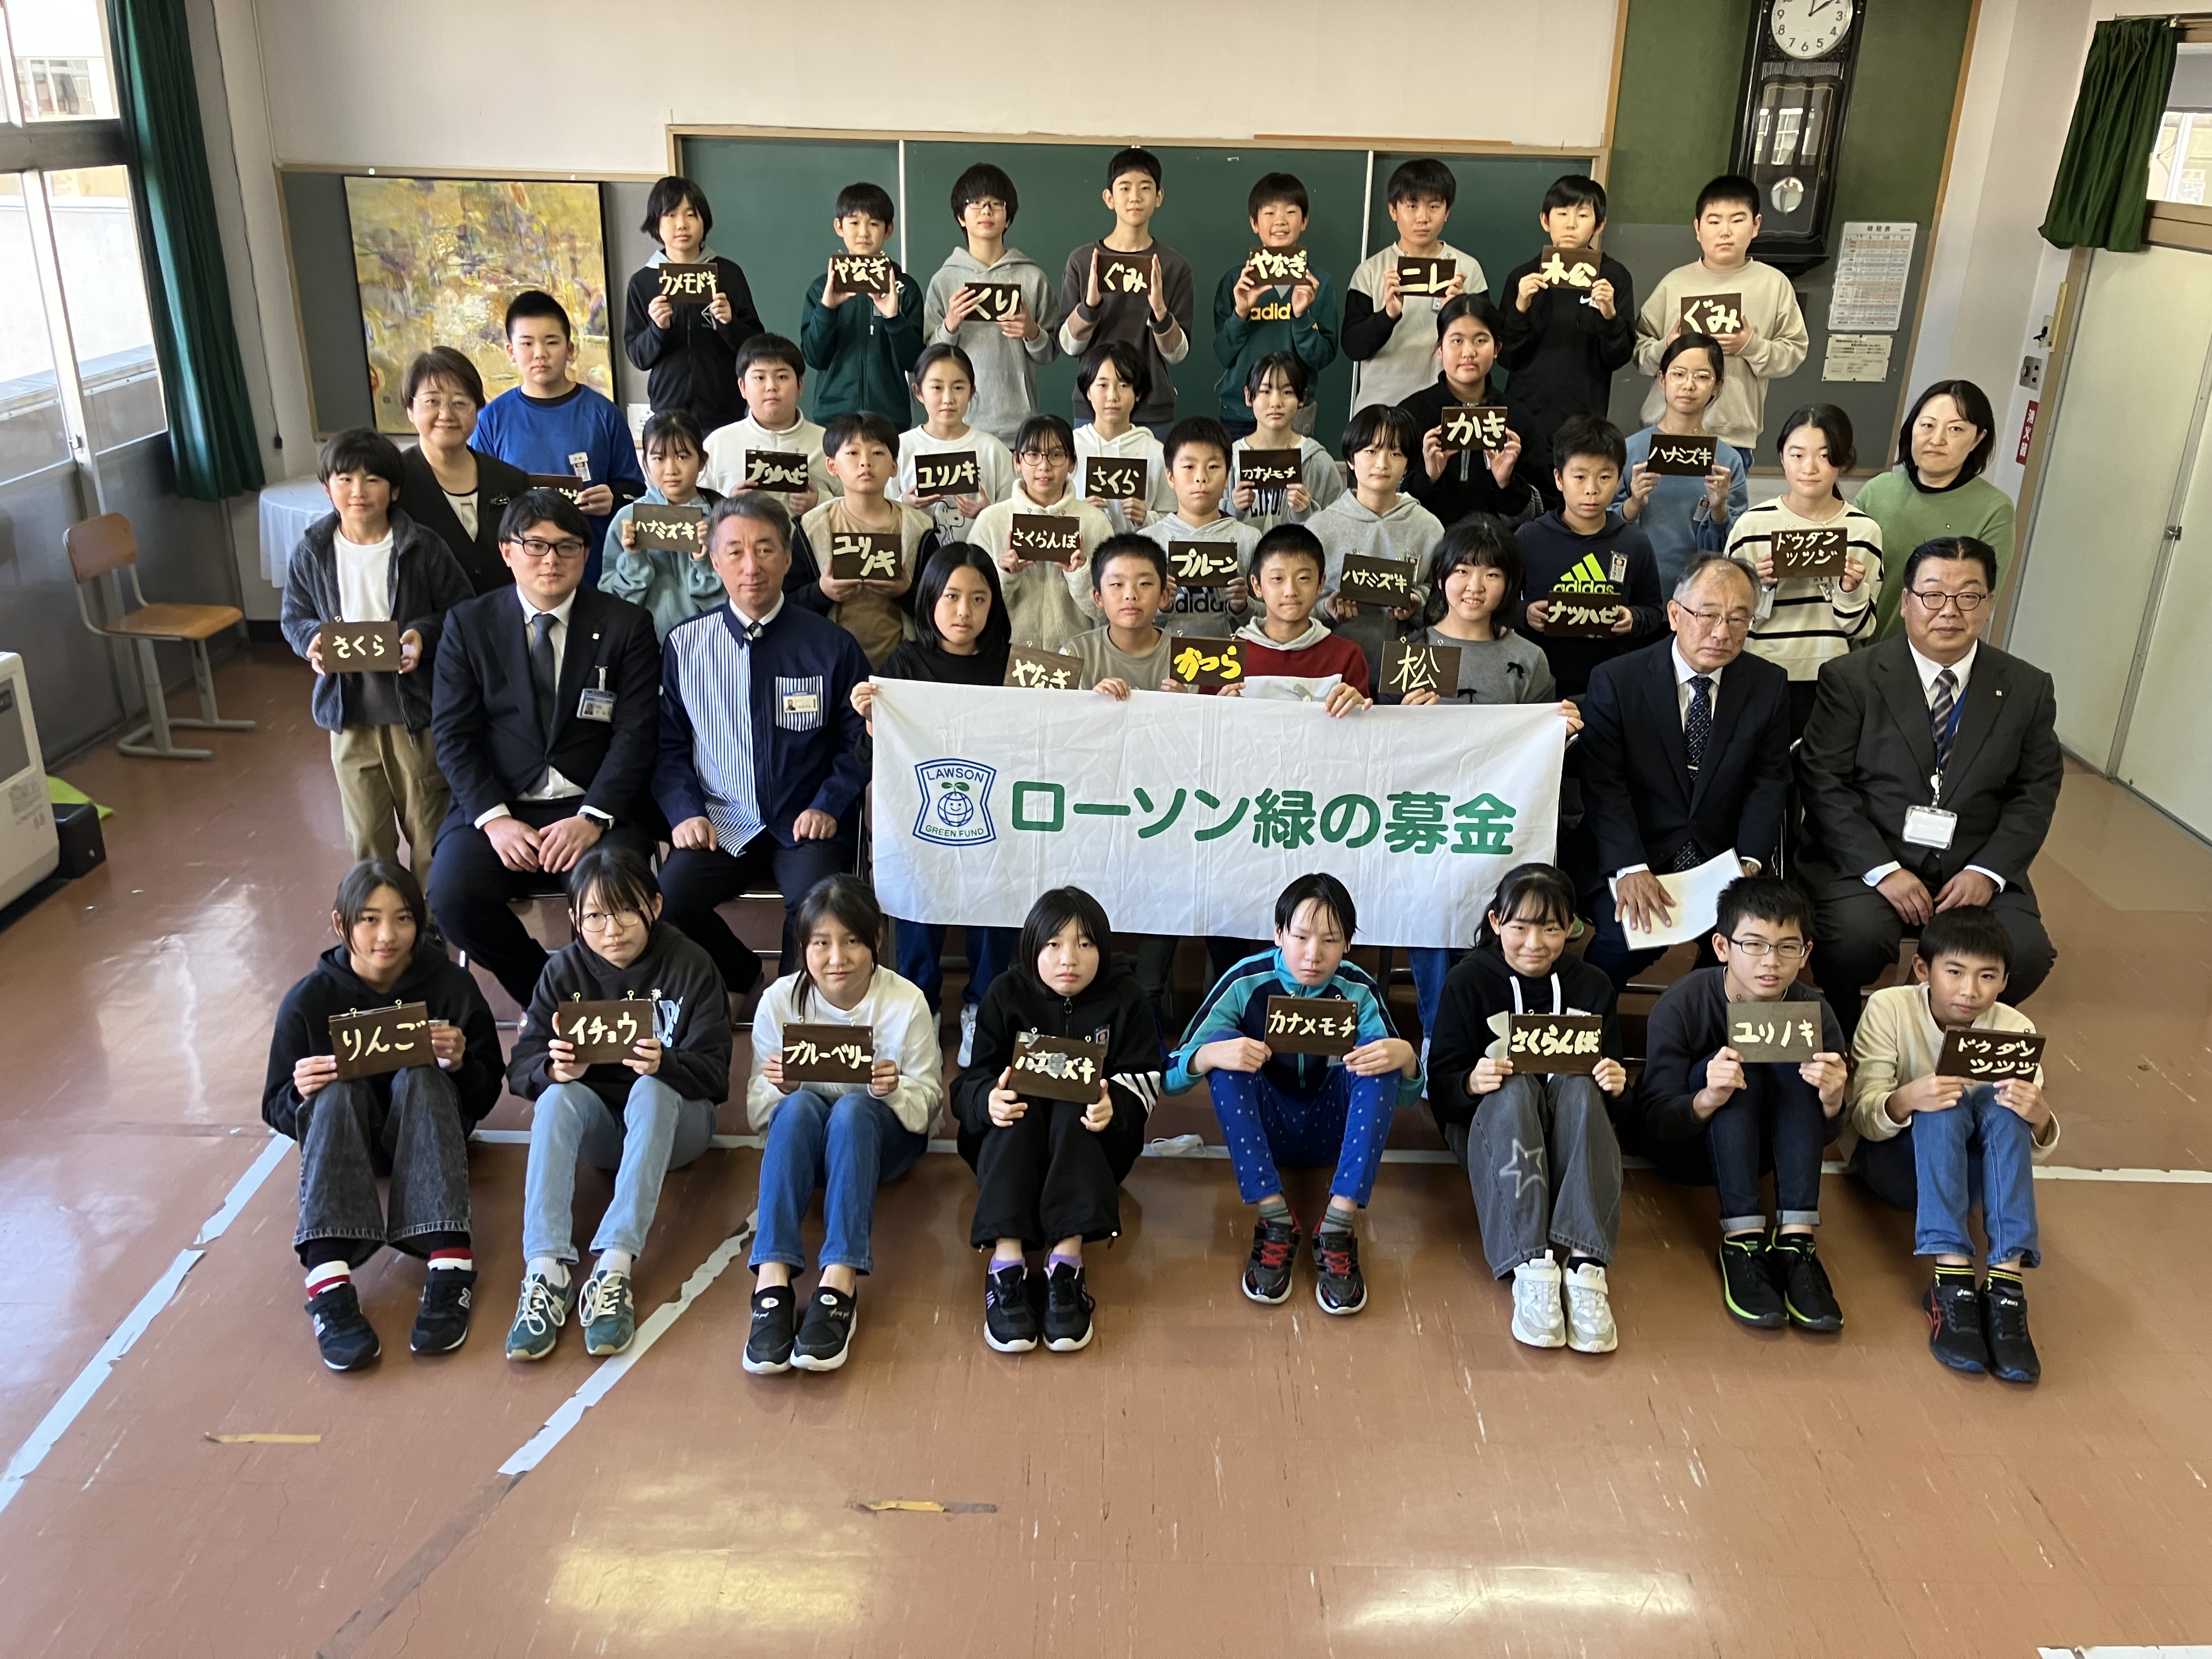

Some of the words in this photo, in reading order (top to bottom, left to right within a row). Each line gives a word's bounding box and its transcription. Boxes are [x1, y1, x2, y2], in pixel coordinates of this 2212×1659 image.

[1777, 9, 1785, 20] 9
[1836, 10, 1843, 21] 3
[1778, 25, 1785, 35] 8
[1788, 38, 1796, 48] 7
[1816, 38, 1824, 48] 5
[1829, 26, 1838, 36] 4
[1801, 42, 1809, 52] 6
[834, 257, 889, 290] やなぎ
[1104, 262, 1148, 293] ぐみ
[1250, 249, 1307, 279] やなぎ
[659, 269, 716, 300] ウメモドキ
[1400, 263, 1450, 294] ニレ
[975, 287, 1019, 321] くり
[1250, 303, 1291, 320] adid
[1684, 300, 1740, 334] ぐみ
[1447, 410, 1506, 448] かき
[1648, 445, 1712, 466] ハナミズキ
[918, 460, 980, 489] ユリノキ
[1090, 465, 1139, 495] さくら
[1242, 466, 1296, 482] カナメモチ
[636, 520, 695, 540] ハナミズキ
[1012, 527, 1079, 550] さくらんぼ
[1777, 531, 1840, 552] ドウダン
[833, 535, 872, 560] ユリ
[860, 549, 896, 578] ノキ
[1171, 549, 1238, 577] プルーン
[1342, 569, 1408, 594] ハナミズキ
[1170, 586, 1229, 613] dida
[1548, 600, 1620, 625] ナツハゼ
[332, 634, 385, 659] さくら
[1012, 659, 1070, 690] やなぎ
[1173, 645, 1242, 682] かつら
[1389, 645, 1441, 693] 松
[926, 767, 985, 783] LAWSON
[925, 825, 956, 838] GREEN
[958, 827, 985, 838] FUND
[1012, 781, 1516, 855] ローソン緑の募金
[568, 1012, 638, 1045] イチョウ
[1268, 1009, 1356, 1039] カナメモチ
[1733, 1018, 1815, 1048] ユリノキ
[343, 1020, 426, 1061] りんご
[1958, 1037, 2035, 1057] ドウダン
[783, 1040, 873, 1069] ブルーベリー
